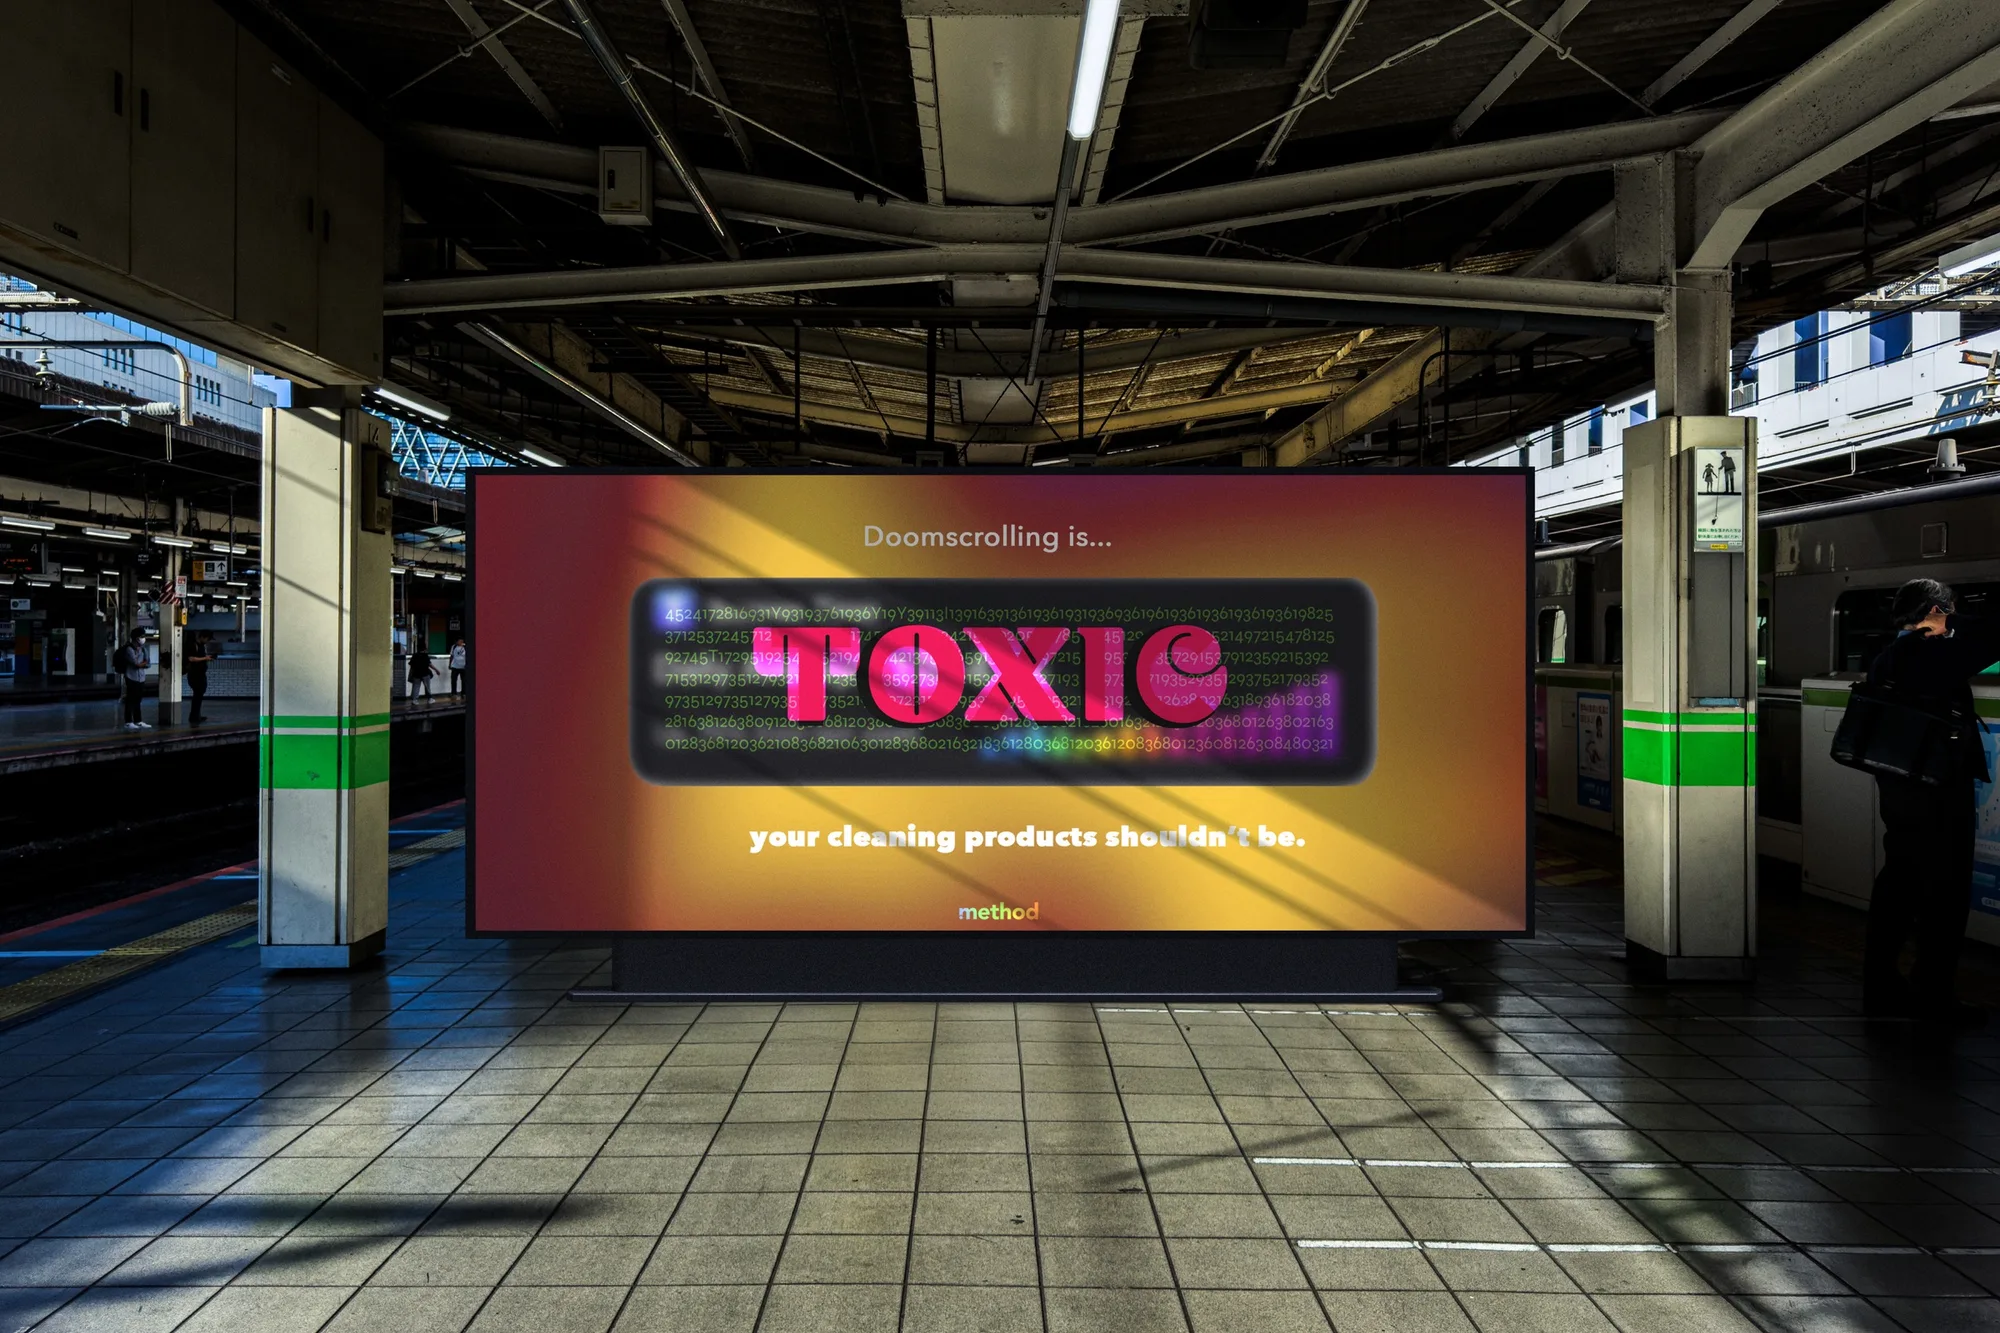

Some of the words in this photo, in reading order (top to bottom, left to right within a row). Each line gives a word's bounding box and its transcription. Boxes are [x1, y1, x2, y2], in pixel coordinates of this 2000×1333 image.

[864, 524, 1059, 553] Doomscrolling
[1069, 525, 1112, 547] is...
[752, 624, 1228, 724] TOXIC
[749, 830, 820, 854] your
[827, 823, 956, 854] cleaning
[964, 824, 1098, 854] products
[1258, 824, 1306, 847] be.
[958, 901, 1039, 920] method
